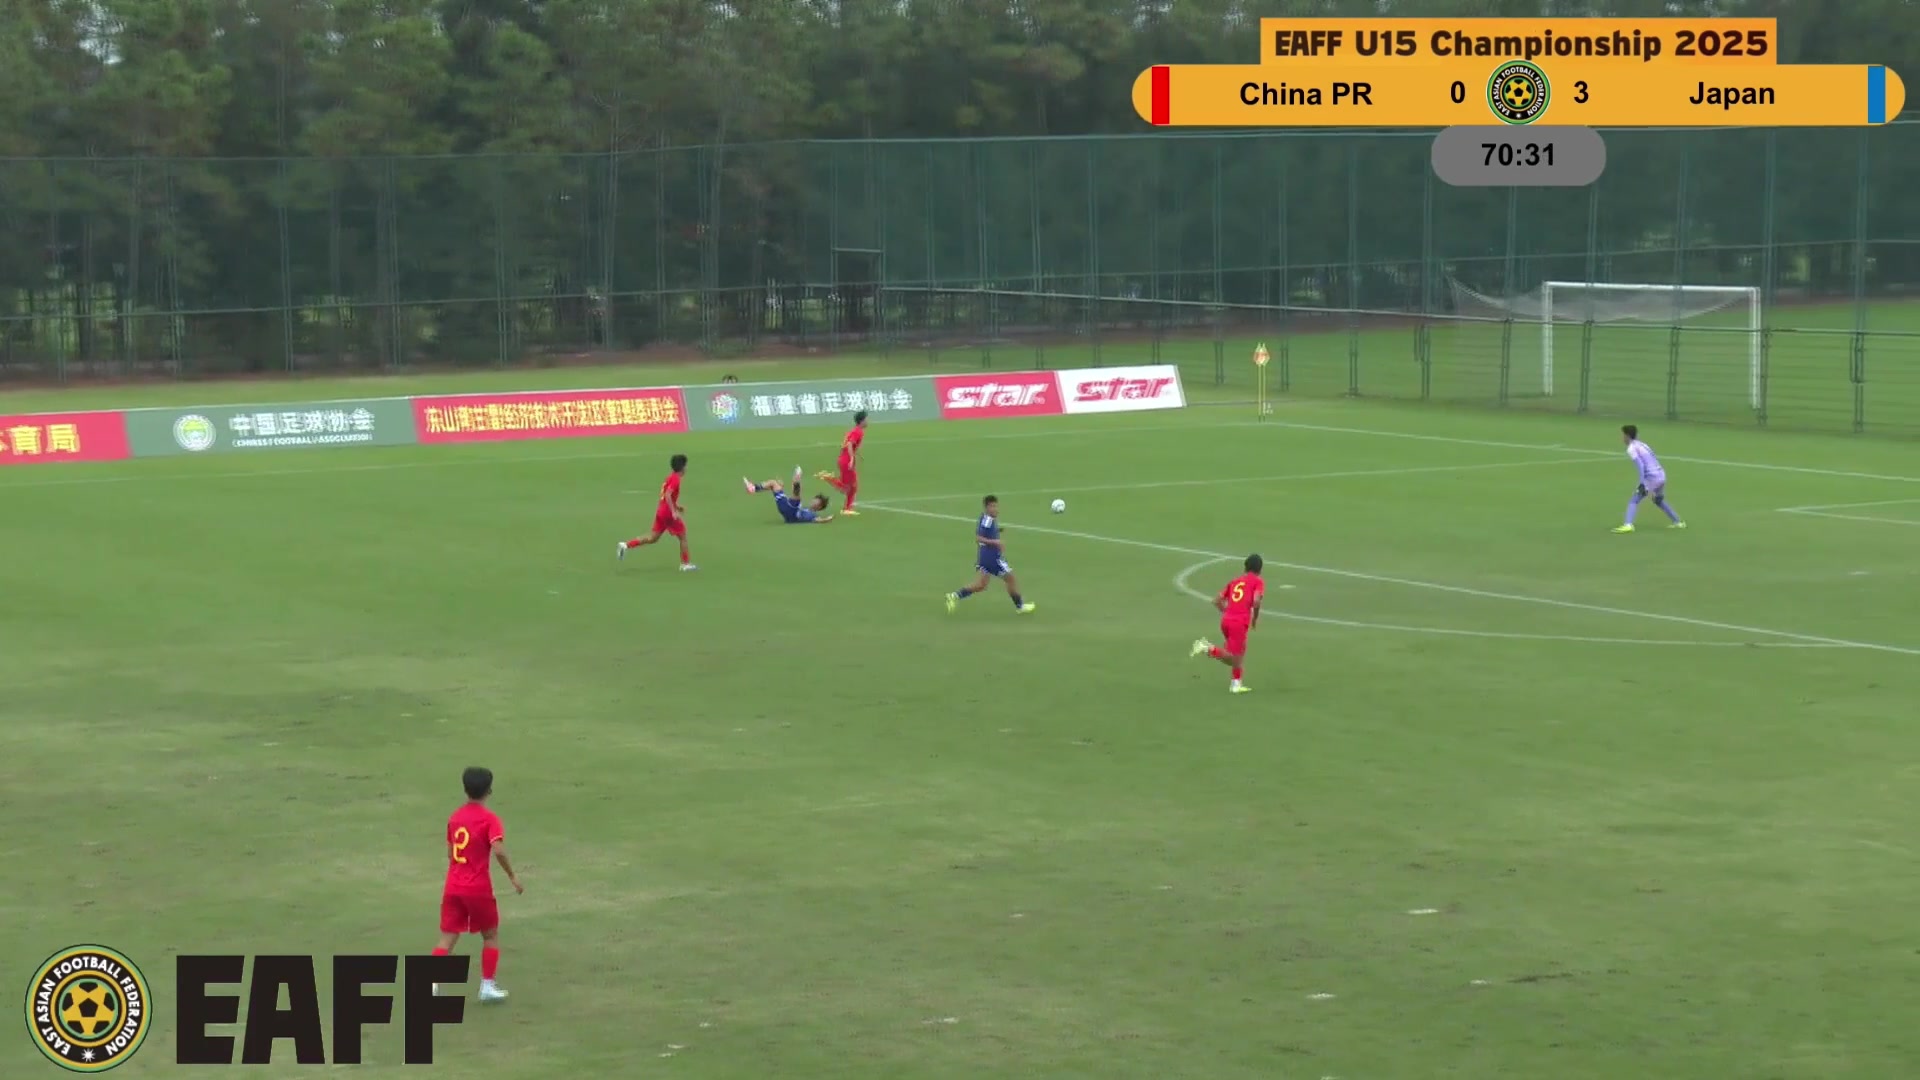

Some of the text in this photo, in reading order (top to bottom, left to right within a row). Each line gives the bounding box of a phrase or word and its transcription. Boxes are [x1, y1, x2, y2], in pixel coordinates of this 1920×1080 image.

[751, 388, 912, 416] 福建省足球协会
[229, 407, 375, 437] 中国足球协会
[1231, 581, 1247, 603] 5
[453, 826, 470, 864] 2
